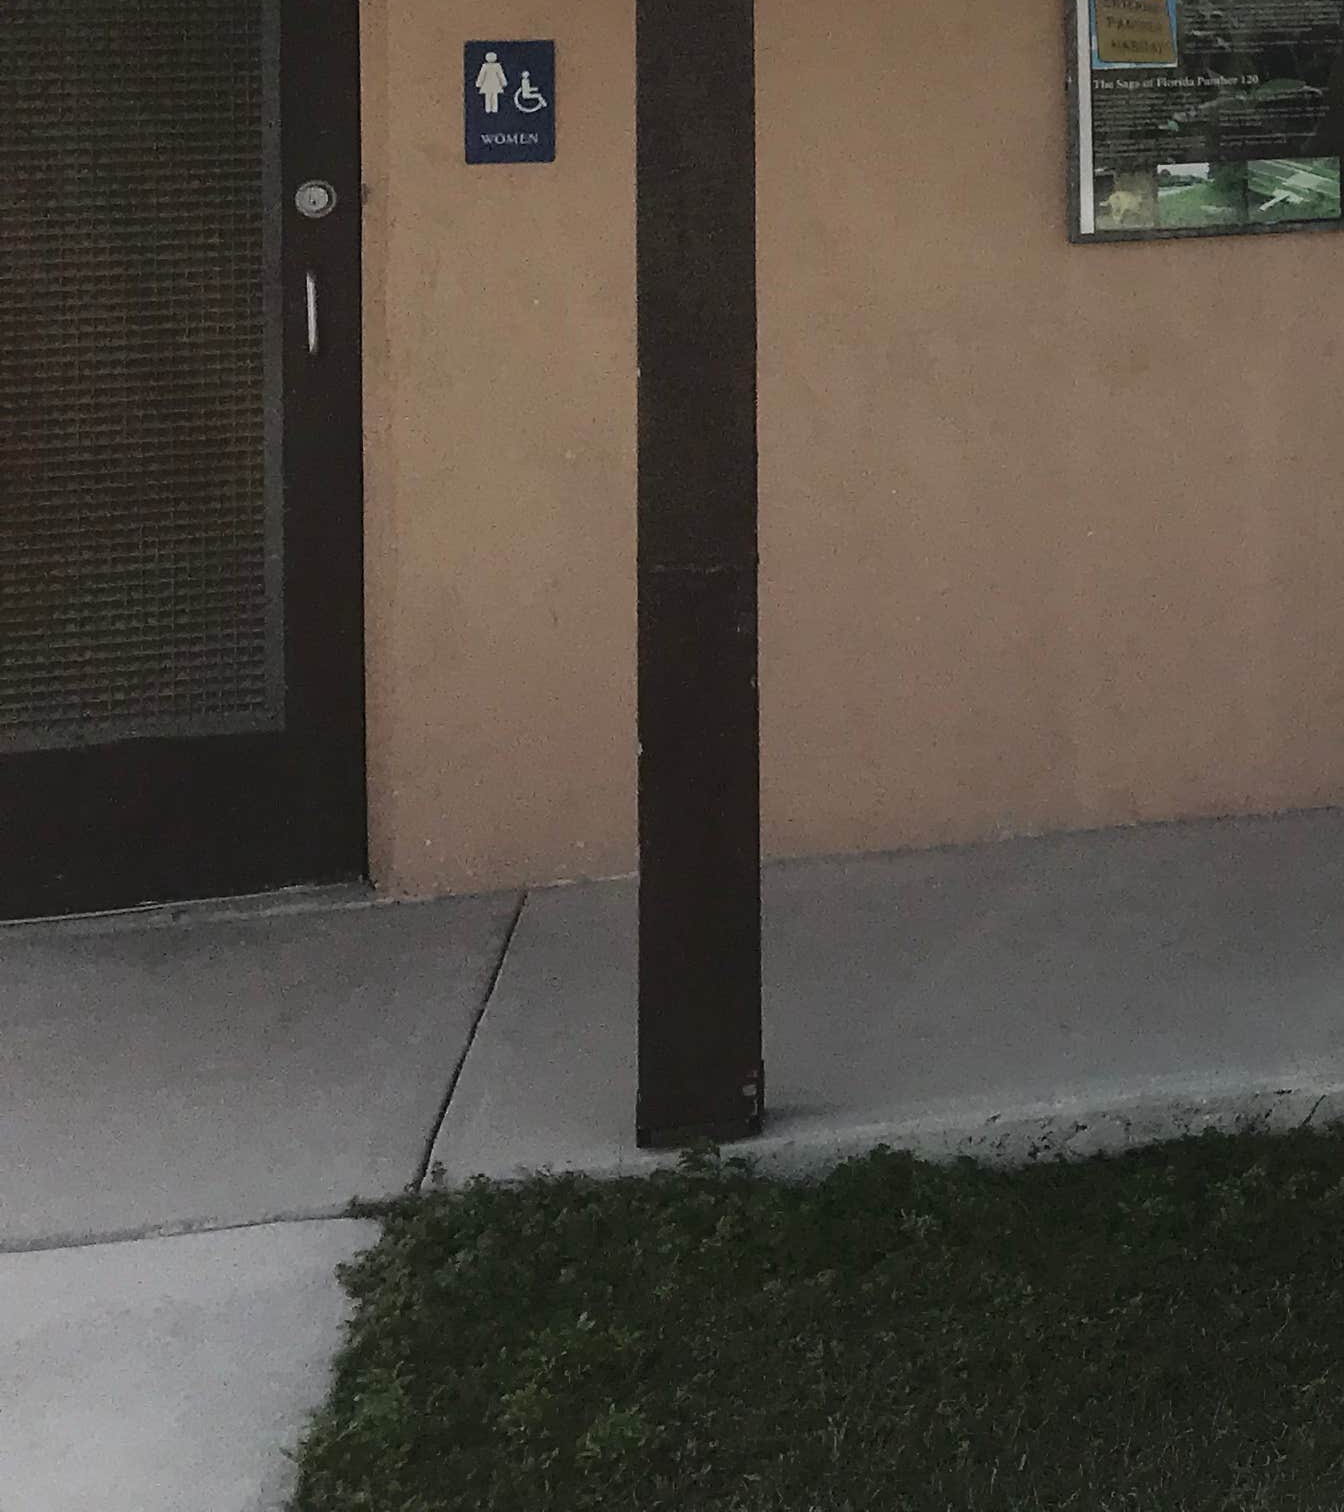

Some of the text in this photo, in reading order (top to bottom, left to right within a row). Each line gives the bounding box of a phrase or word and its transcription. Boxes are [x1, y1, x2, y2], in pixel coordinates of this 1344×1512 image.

[1093, 79, 1113, 89] The
[1156, 76, 1194, 87] Florida
[1197, 75, 1238, 87] Panther
[480, 132, 539, 144] WOMEN
